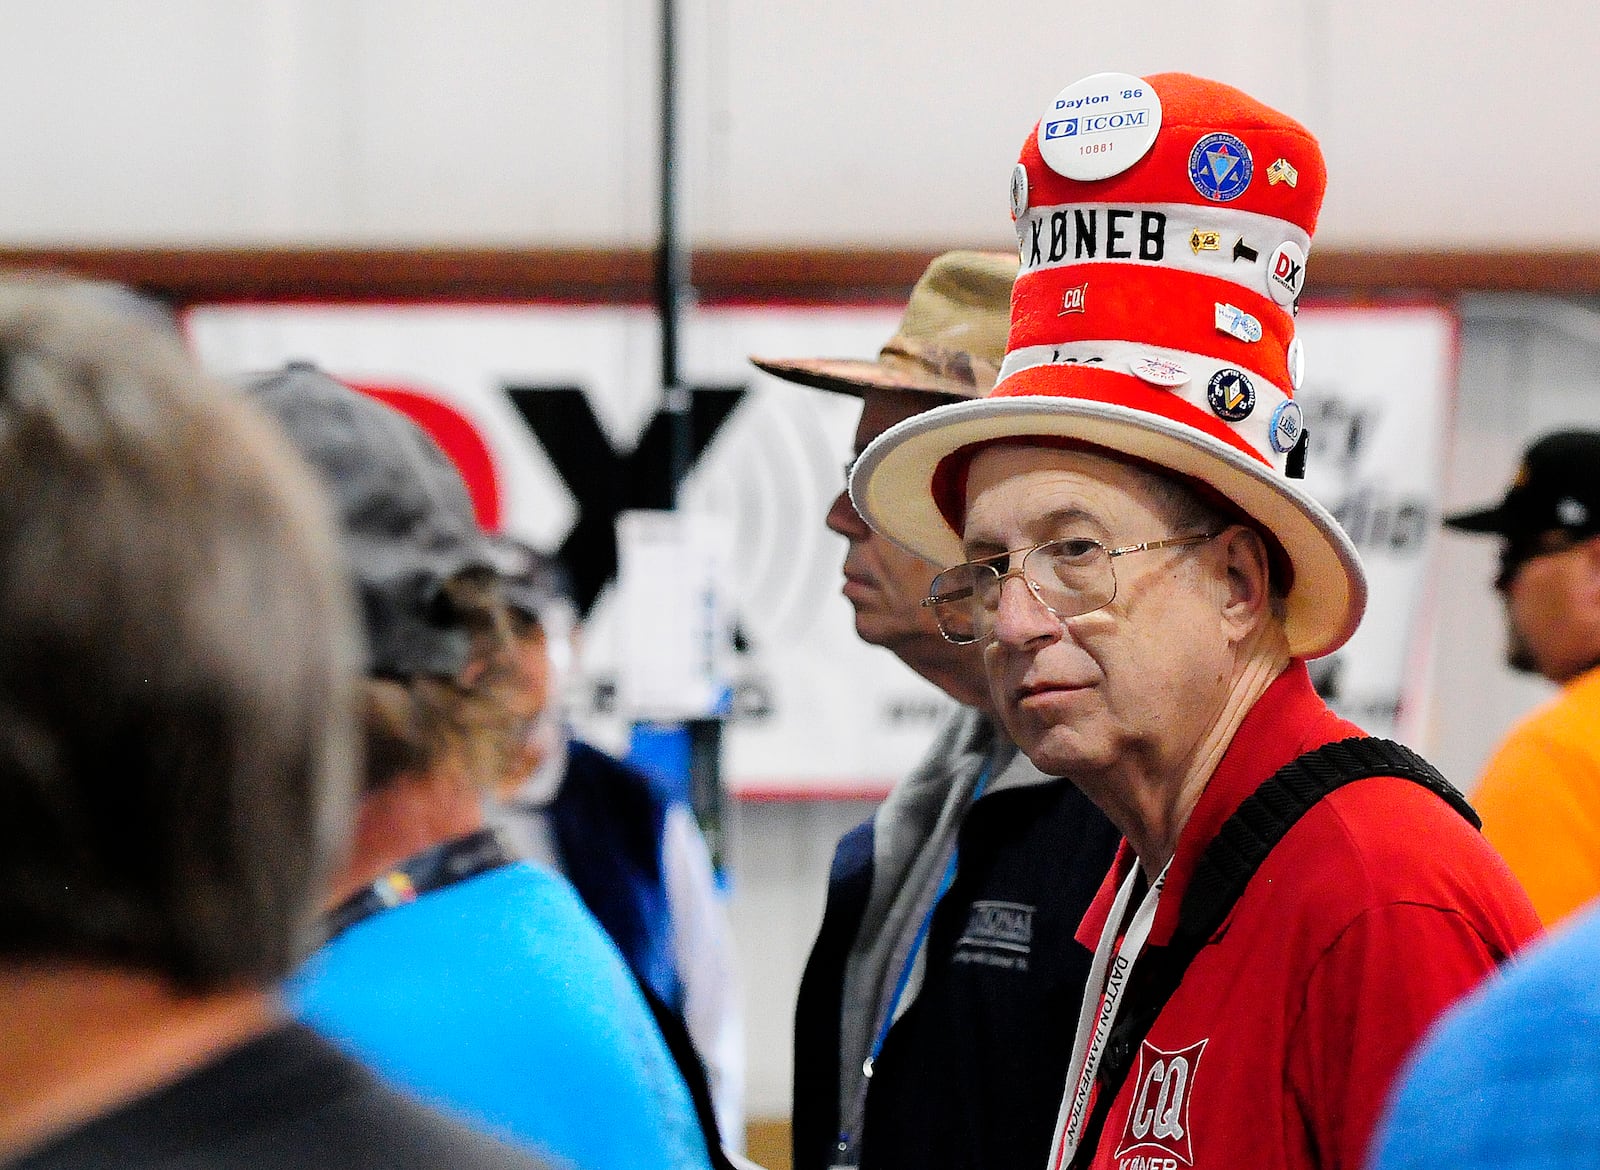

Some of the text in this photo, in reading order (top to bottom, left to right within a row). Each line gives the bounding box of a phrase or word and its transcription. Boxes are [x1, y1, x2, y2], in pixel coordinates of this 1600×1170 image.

[1055, 88, 1143, 110] Dayton '86
[1084, 111, 1146, 132] ICOM
[1079, 142, 1114, 156] 10881
[1274, 251, 1302, 289] DX
[1064, 288, 1081, 309] CQ
[1101, 956, 1128, 1027] DAYTON
[1132, 1055, 1189, 1141] CQ
